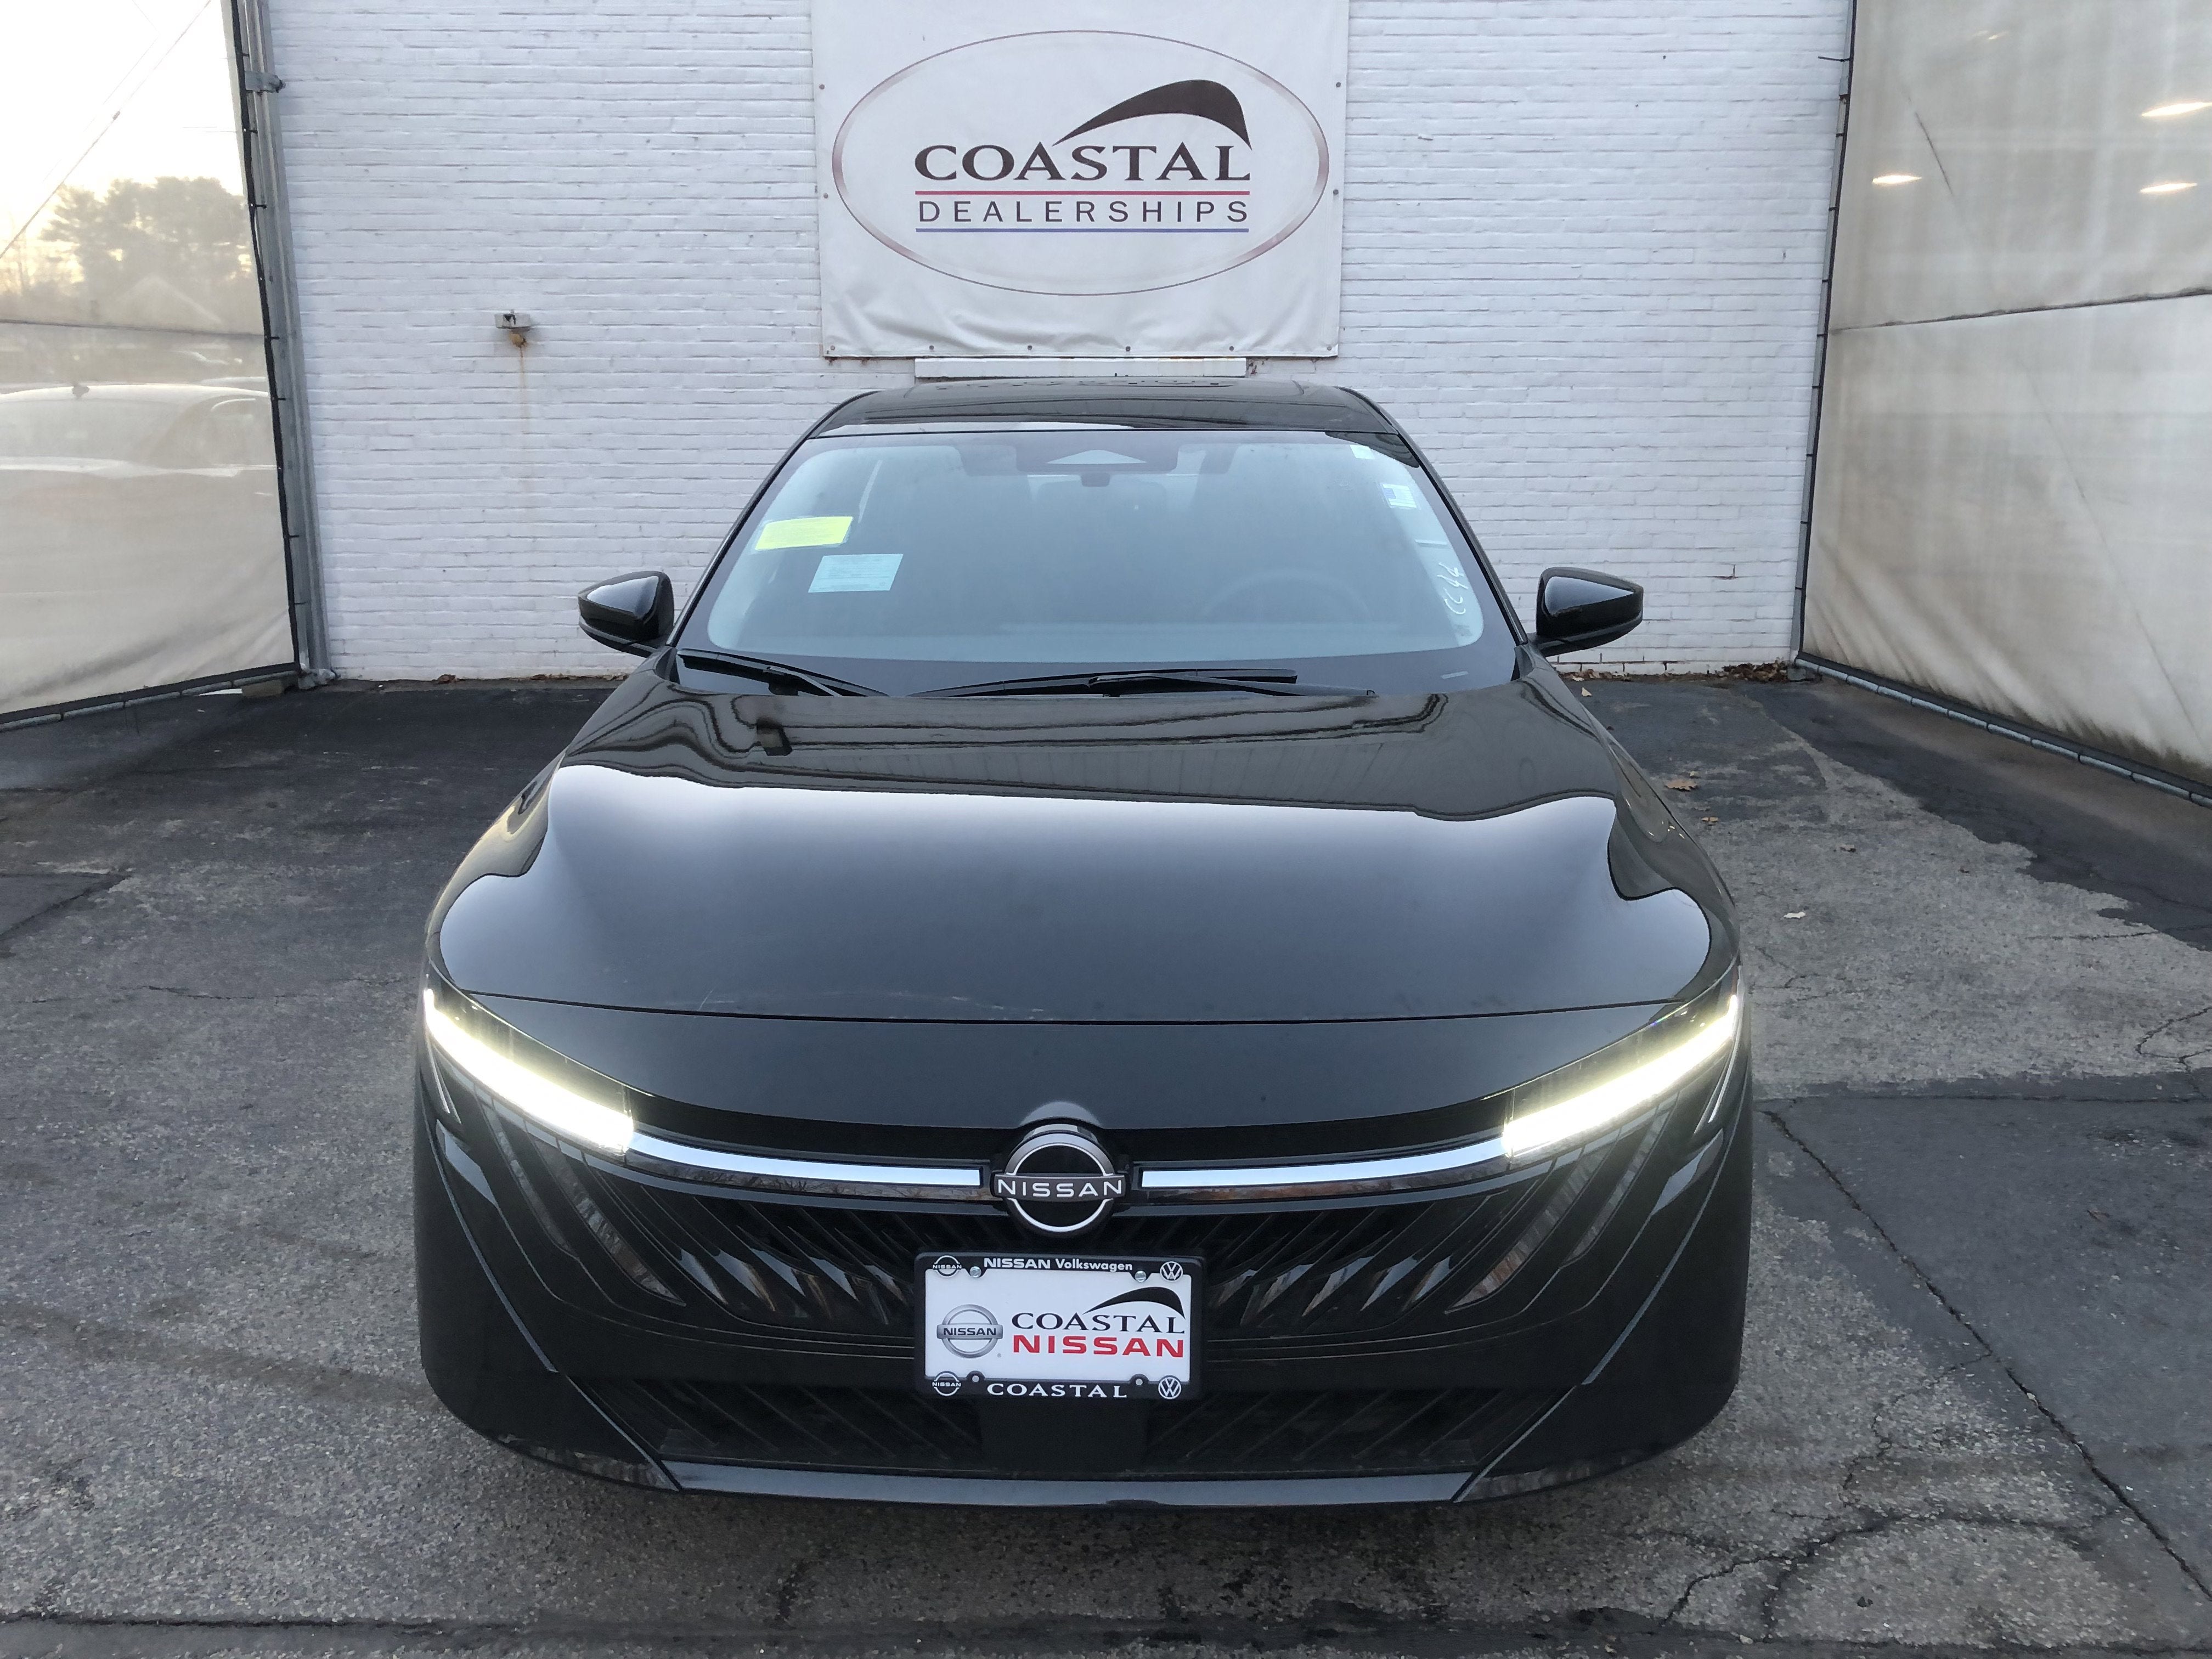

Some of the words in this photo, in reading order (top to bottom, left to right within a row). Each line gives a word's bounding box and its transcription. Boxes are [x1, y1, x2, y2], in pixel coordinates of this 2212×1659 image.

[914, 142, 1250, 182] COASTAL
[918, 200, 1248, 223] DEALERSHIPS
[997, 1179, 1122, 1198] NISSAN
[984, 1257, 1051, 1269] NISSAN
[1055, 1259, 1133, 1273] Volkswagen
[943, 1327, 997, 1336] NISSAN
[1012, 1312, 1185, 1334] COASTAL
[1013, 1334, 1184, 1358] NISSAN
[987, 1383, 1127, 1398] COASTAL
